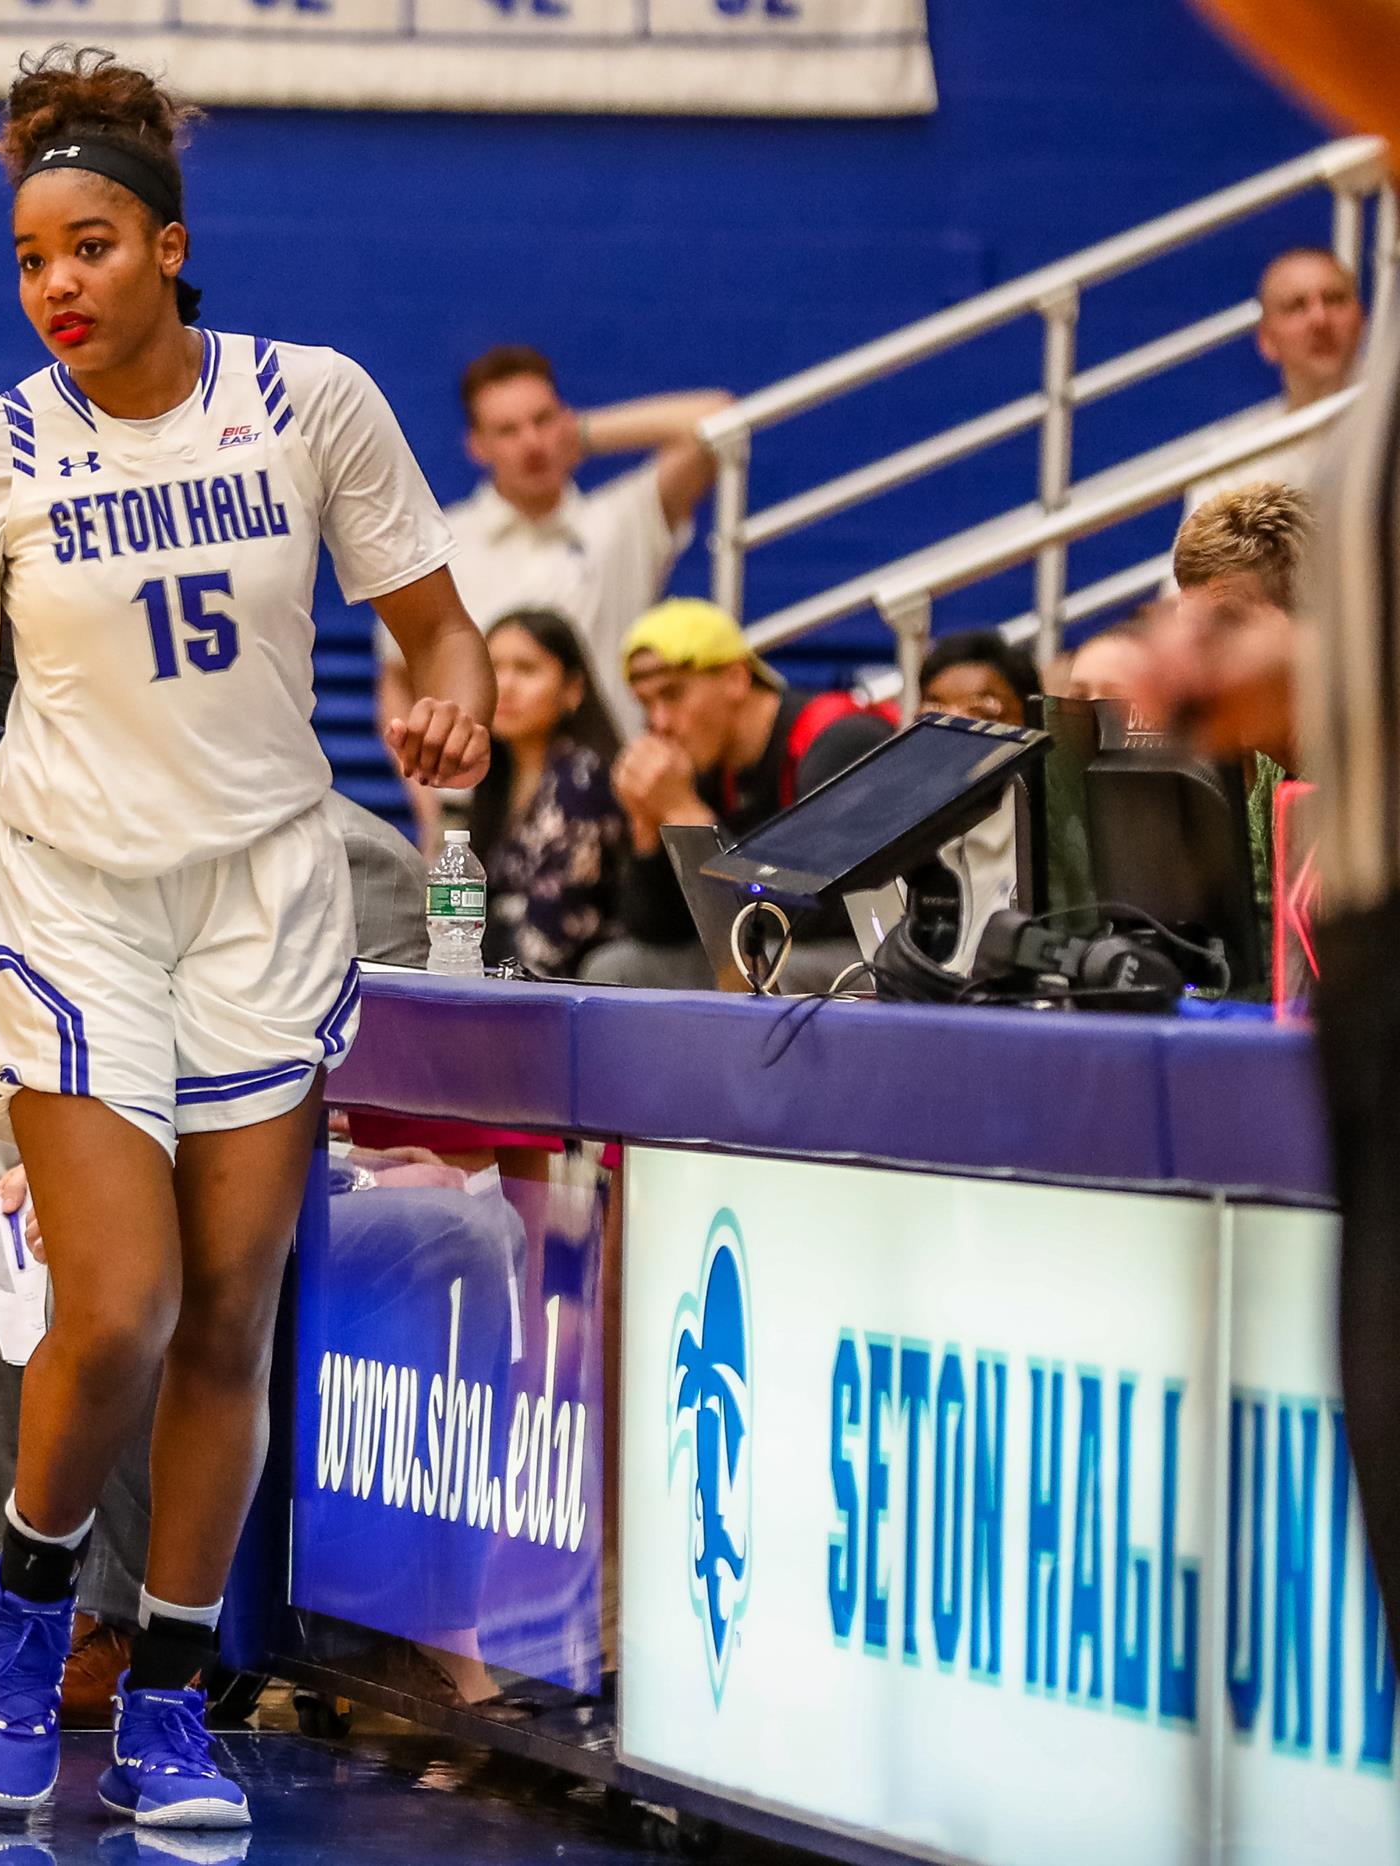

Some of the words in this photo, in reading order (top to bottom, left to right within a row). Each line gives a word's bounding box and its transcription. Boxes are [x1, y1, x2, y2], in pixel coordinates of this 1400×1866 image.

[219, 431, 262, 446] EAST
[222, 424, 252, 437] BIG
[47, 483, 183, 564] SETON
[177, 469, 292, 546] HALL
[130, 568, 242, 684] 15
[317, 1276, 588, 1554] www.shu.edu
[825, 1326, 1010, 1688] SETON
[1022, 1354, 1201, 1734] HALL
